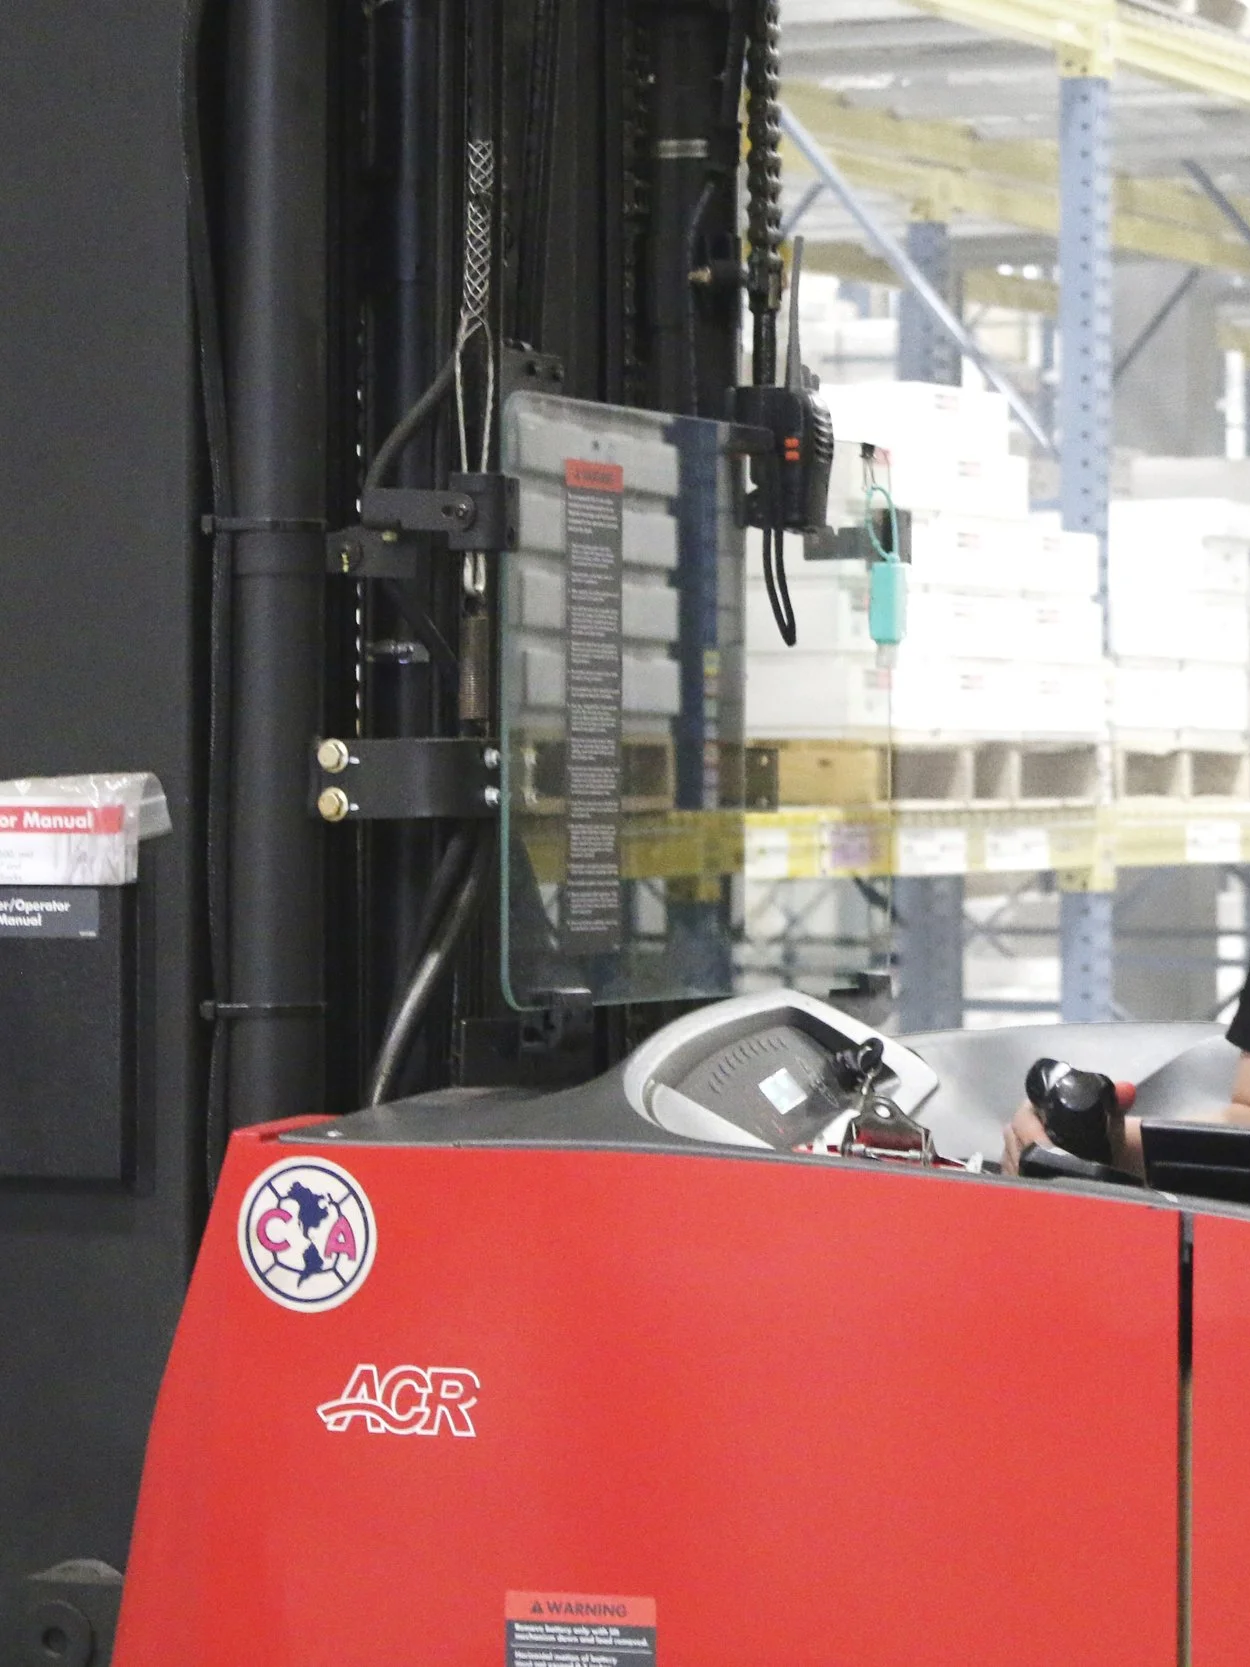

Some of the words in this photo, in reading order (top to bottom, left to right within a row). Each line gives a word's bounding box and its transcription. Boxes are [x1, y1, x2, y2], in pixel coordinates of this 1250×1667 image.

[23, 811, 94, 829] Manual
[257, 1208, 292, 1251] C
[324, 1215, 356, 1261] A
[316, 1364, 480, 1437] ACR
[547, 1601, 627, 1617] WARNING
